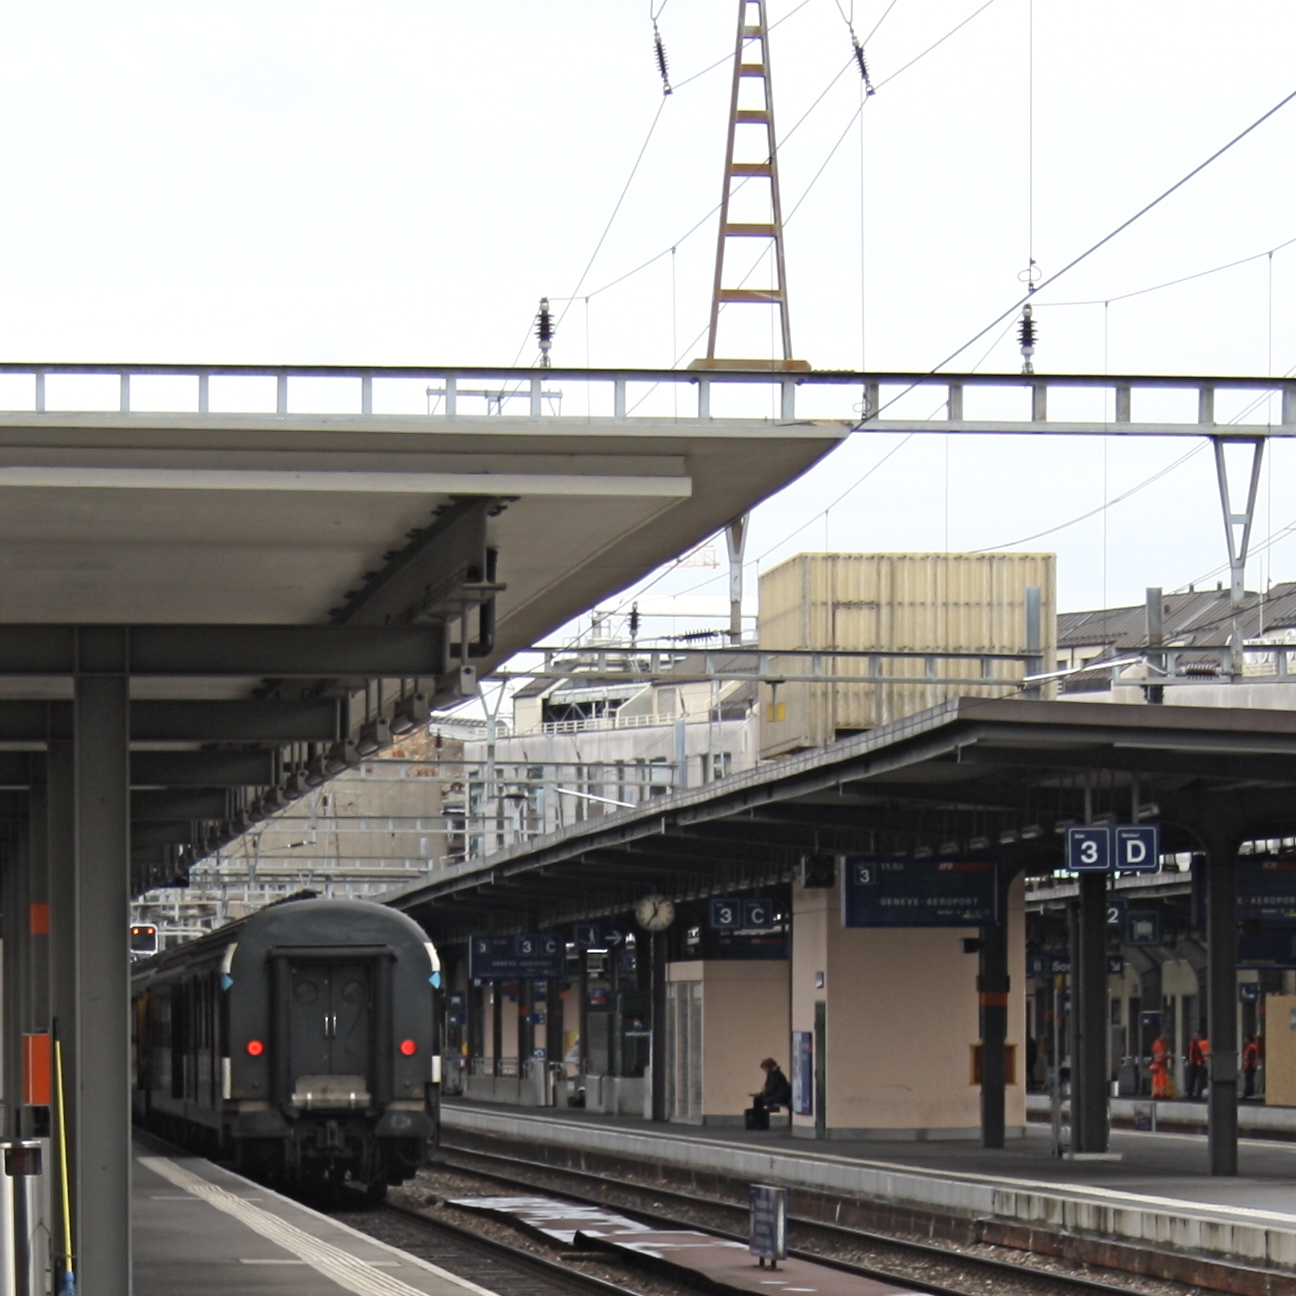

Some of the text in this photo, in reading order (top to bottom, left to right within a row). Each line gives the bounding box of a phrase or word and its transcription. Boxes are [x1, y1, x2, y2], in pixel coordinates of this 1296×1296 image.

[1080, 839, 1147, 864] 3 D
[859, 869, 870, 883] 3
[719, 907, 765, 924] 3 C
[1107, 907, 1119, 924] 2
[479, 943, 487, 953] 3
[522, 940, 557, 953] 3 C
